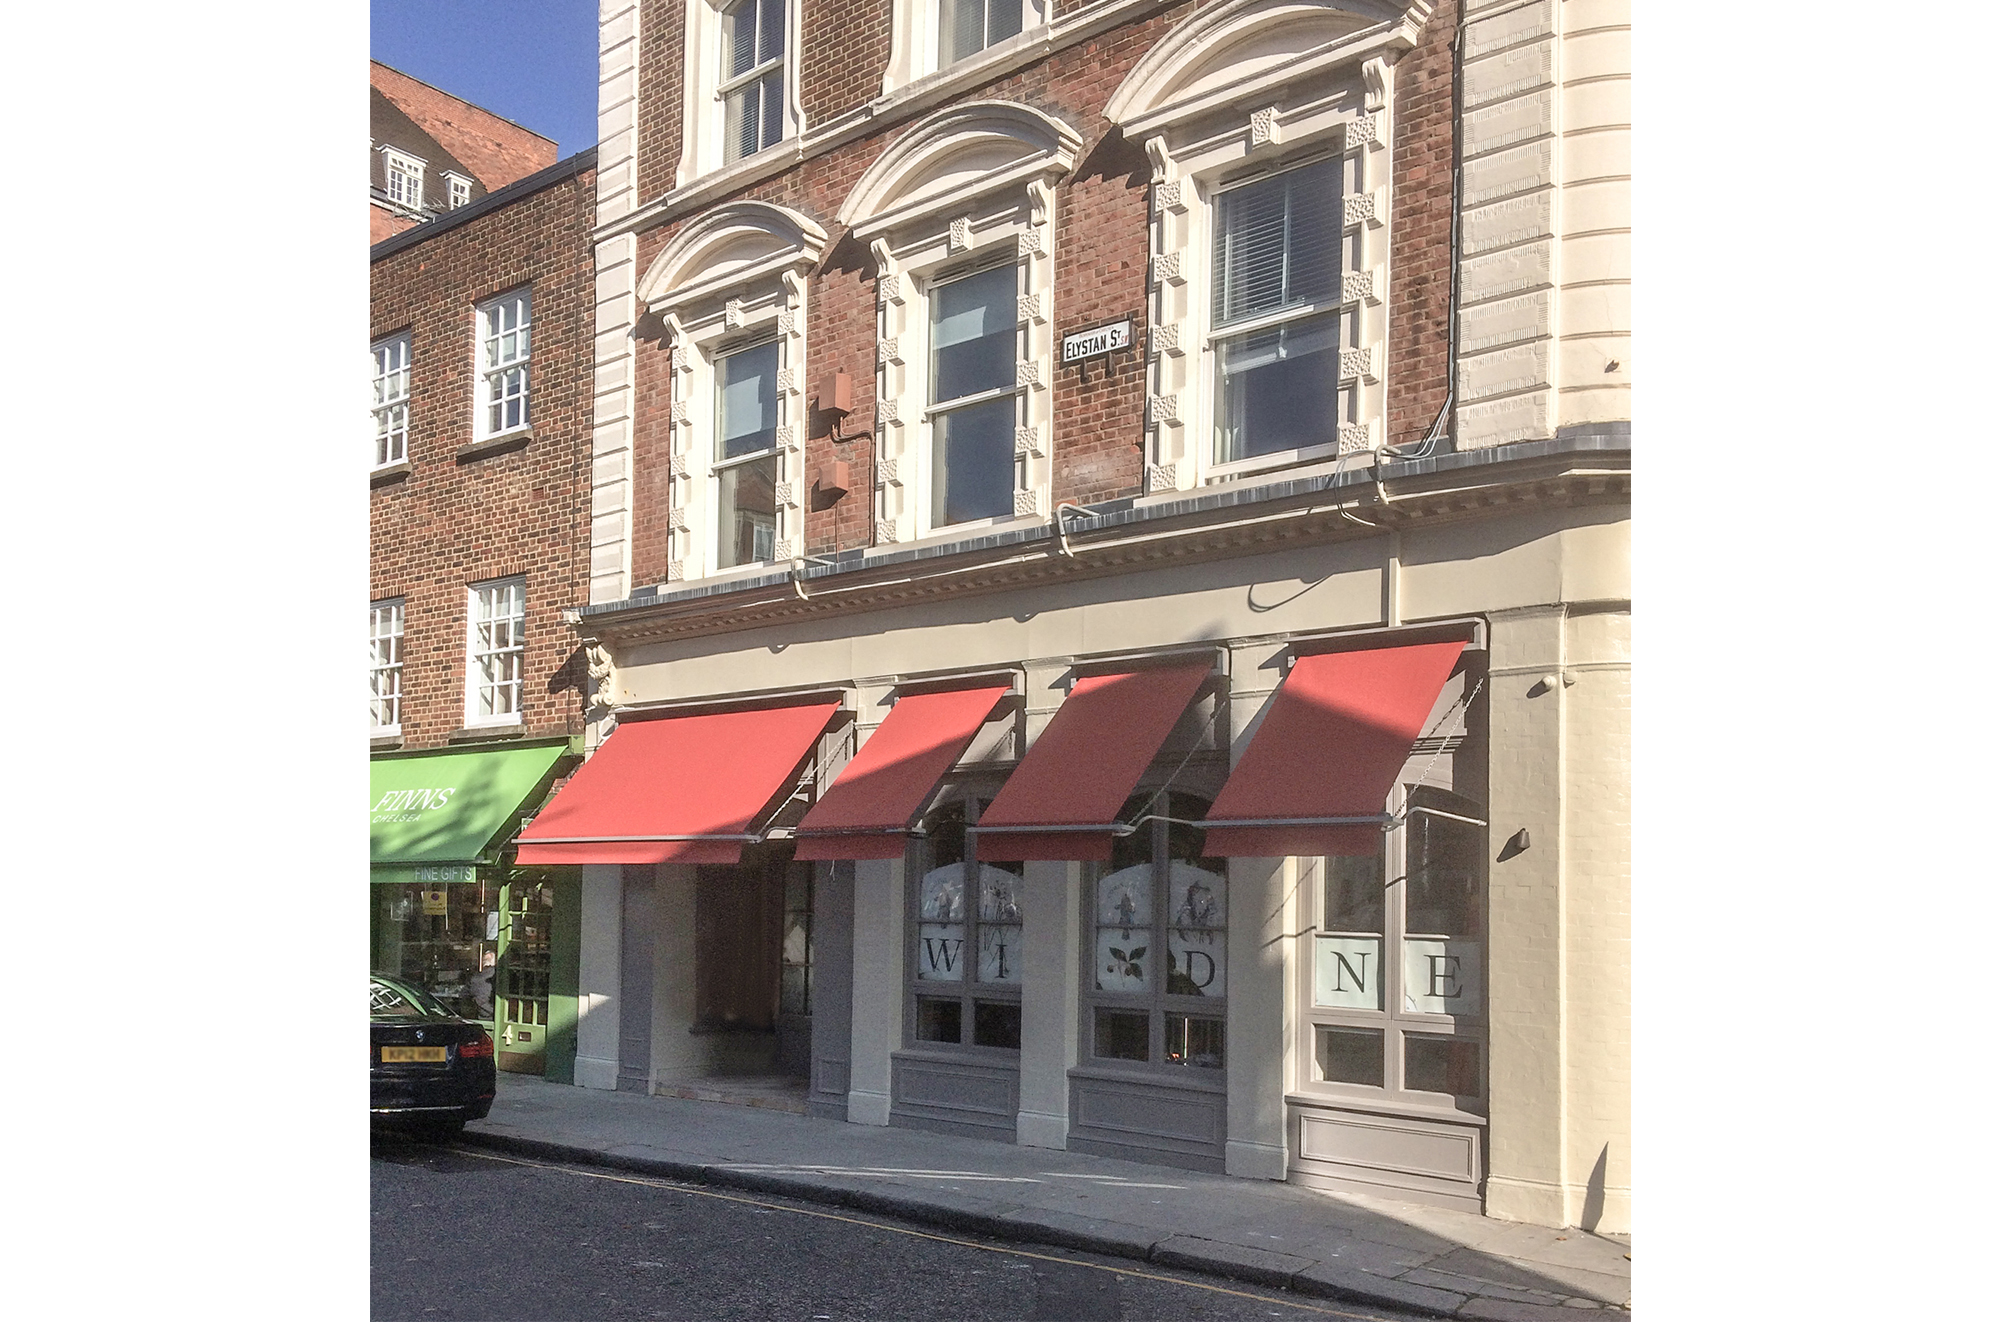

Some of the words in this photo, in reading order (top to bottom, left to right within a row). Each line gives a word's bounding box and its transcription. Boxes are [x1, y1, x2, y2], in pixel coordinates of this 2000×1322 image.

[1066, 334, 1107, 359] ELYSTAN
[371, 787, 456, 812] FINNS
[372, 813, 421, 824] CHELSEA
[415, 867, 438, 881] FINE
[441, 867, 473, 881] GIFTS
